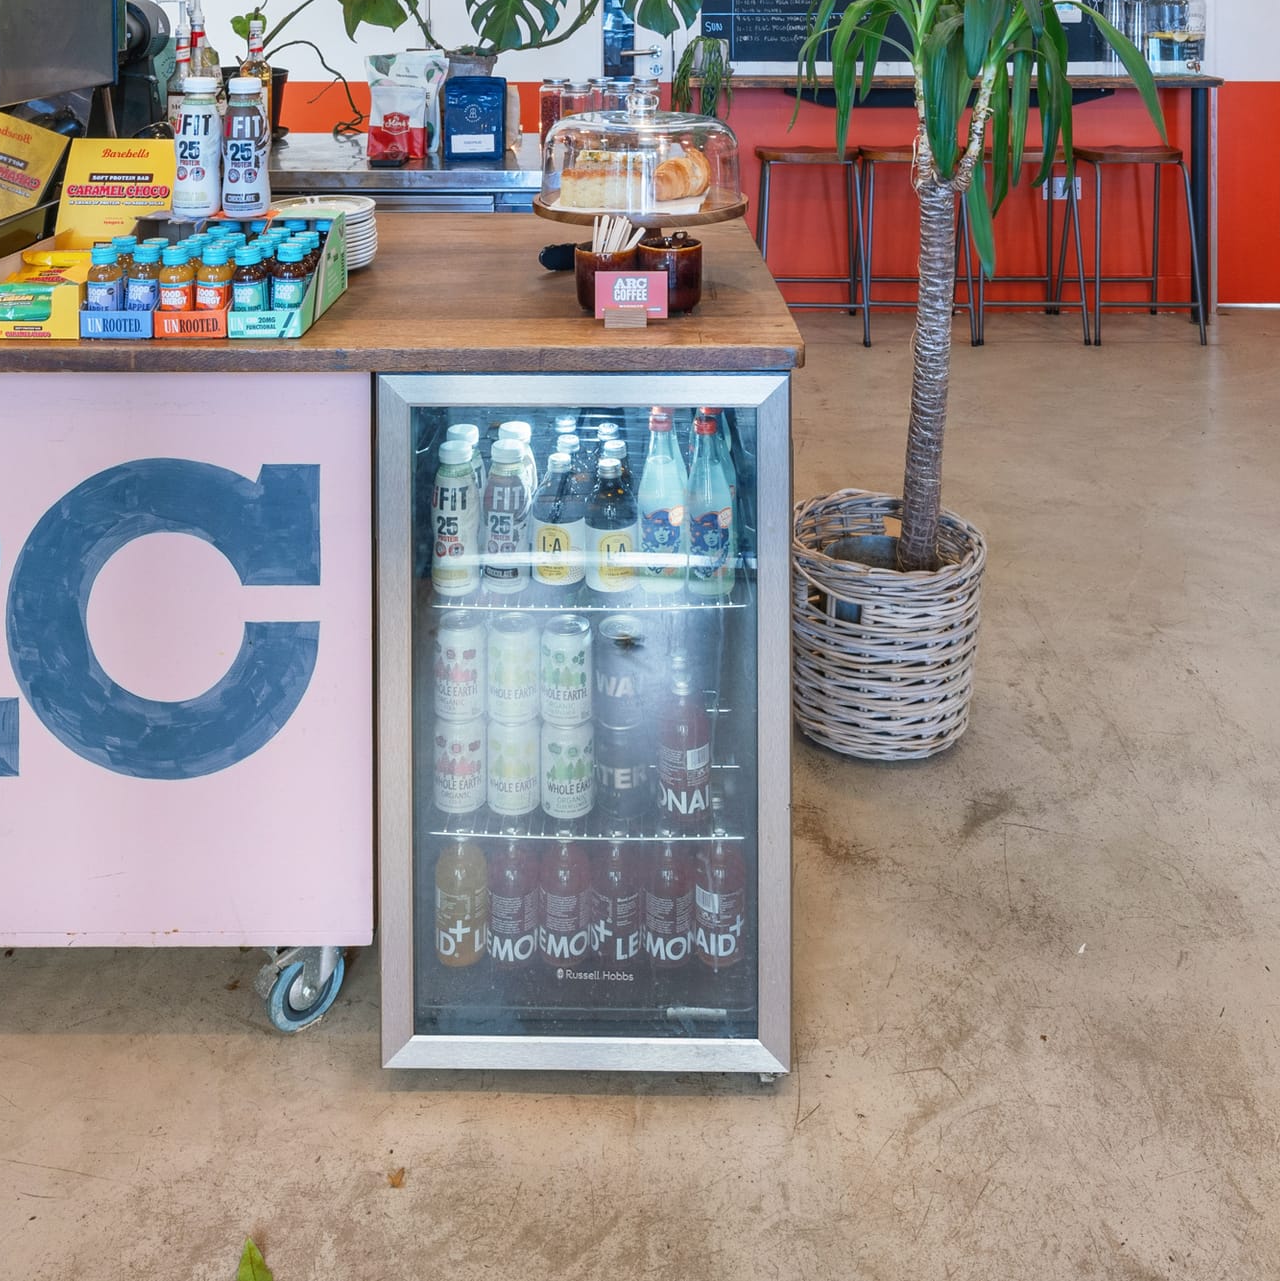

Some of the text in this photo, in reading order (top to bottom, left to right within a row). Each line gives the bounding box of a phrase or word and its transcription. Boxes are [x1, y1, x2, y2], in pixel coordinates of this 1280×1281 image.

[704, 22, 724, 32] SUN
[100, 147, 151, 159] Barebells
[178, 140, 201, 160] 25
[229, 142, 252, 162] 25
[179, 159, 201, 167] PROTEIN
[230, 161, 252, 169] PROTEIN
[66, 184, 170, 199] CARAMEL CHOCO
[613, 277, 648, 289] ARC
[613, 288, 648, 302] COFFEE
[436, 515, 459, 536] 25
[489, 514, 512, 535] 25
[562, 689, 588, 702] EARTH
[547, 782, 575, 795] WHOLE
[565, 968, 635, 983] Russell Hobbs
